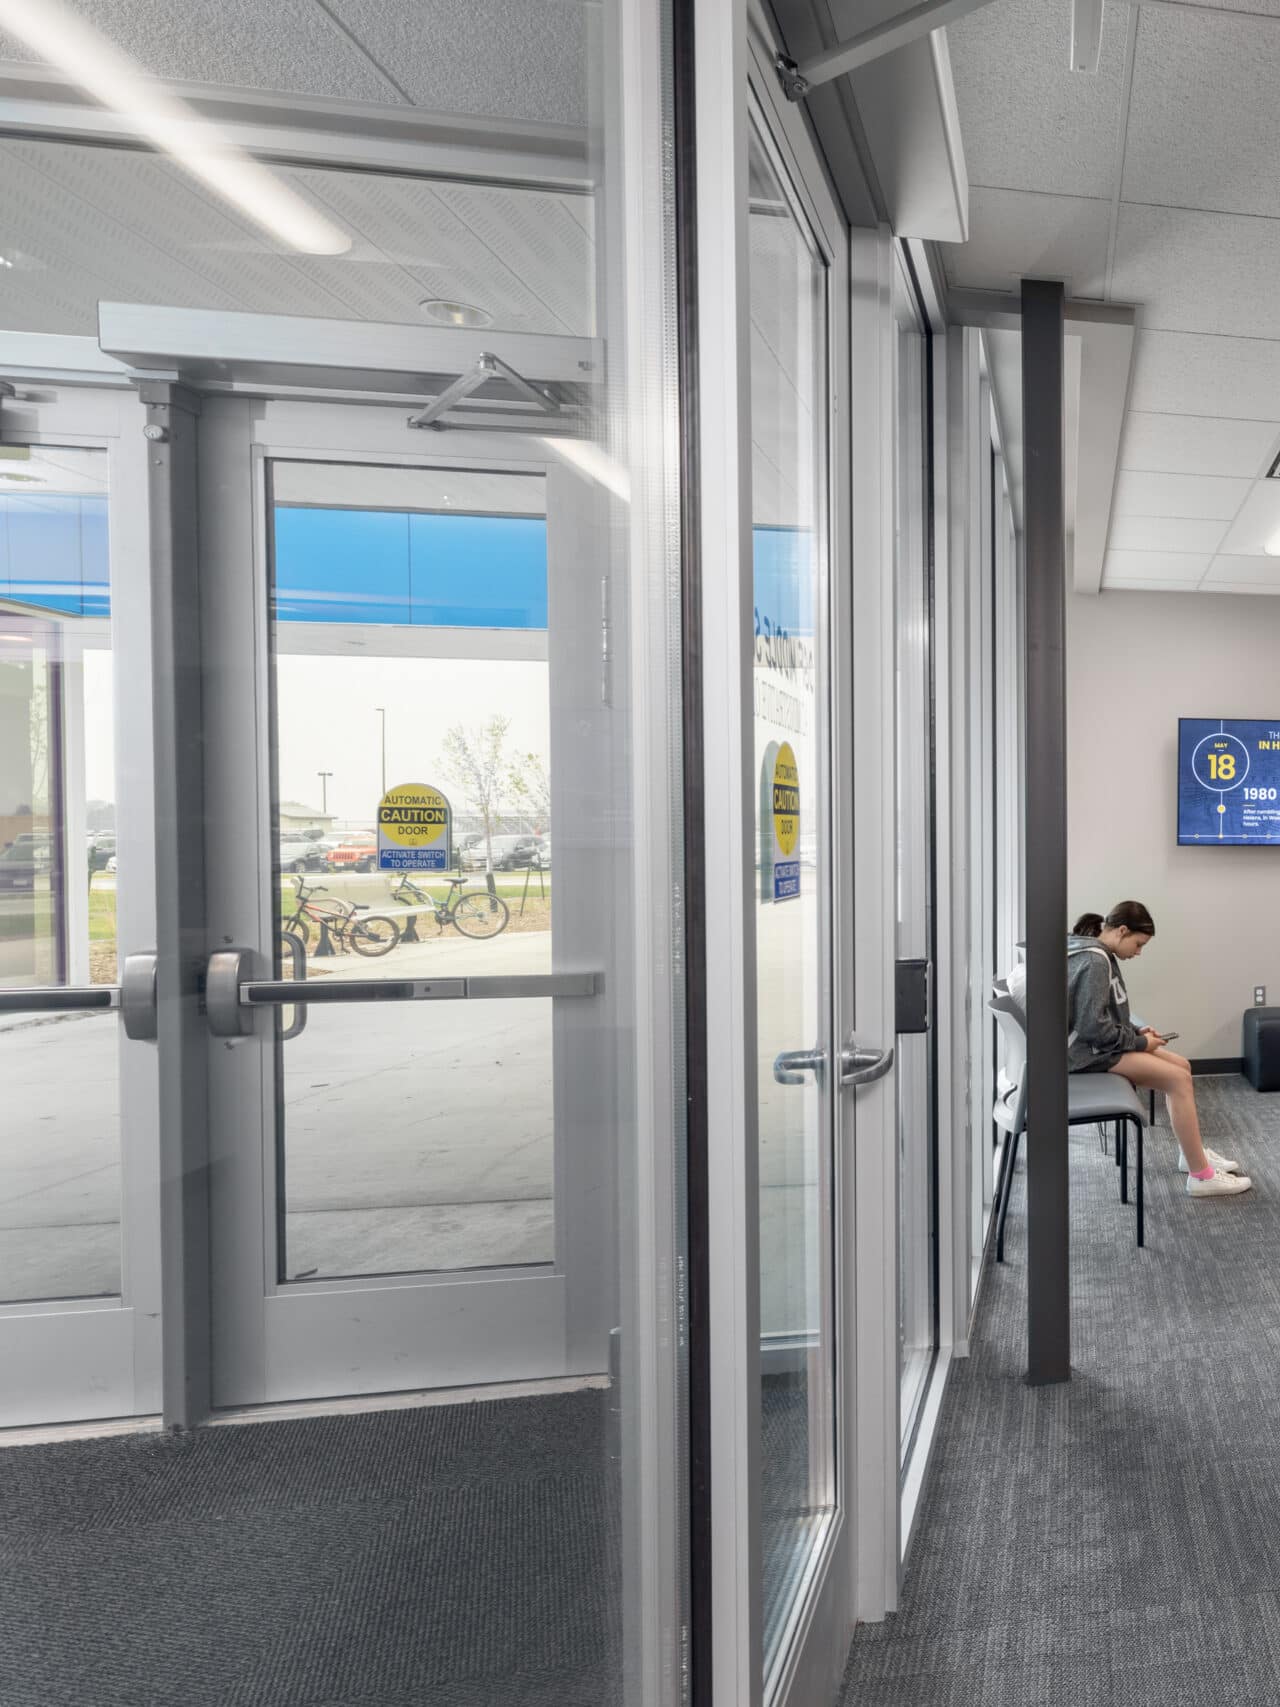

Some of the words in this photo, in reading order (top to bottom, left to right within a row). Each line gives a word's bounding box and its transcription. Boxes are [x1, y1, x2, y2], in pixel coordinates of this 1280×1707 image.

[1259, 741, 1270, 749] IN
[1207, 754, 1236, 780] 18
[1243, 787, 1277, 800] 1980
[384, 795, 441, 805] AUTOMATIC
[381, 809, 445, 822] CAUTION
[398, 826, 428, 835] DOOR
[417, 851, 444, 859] SWITCH
